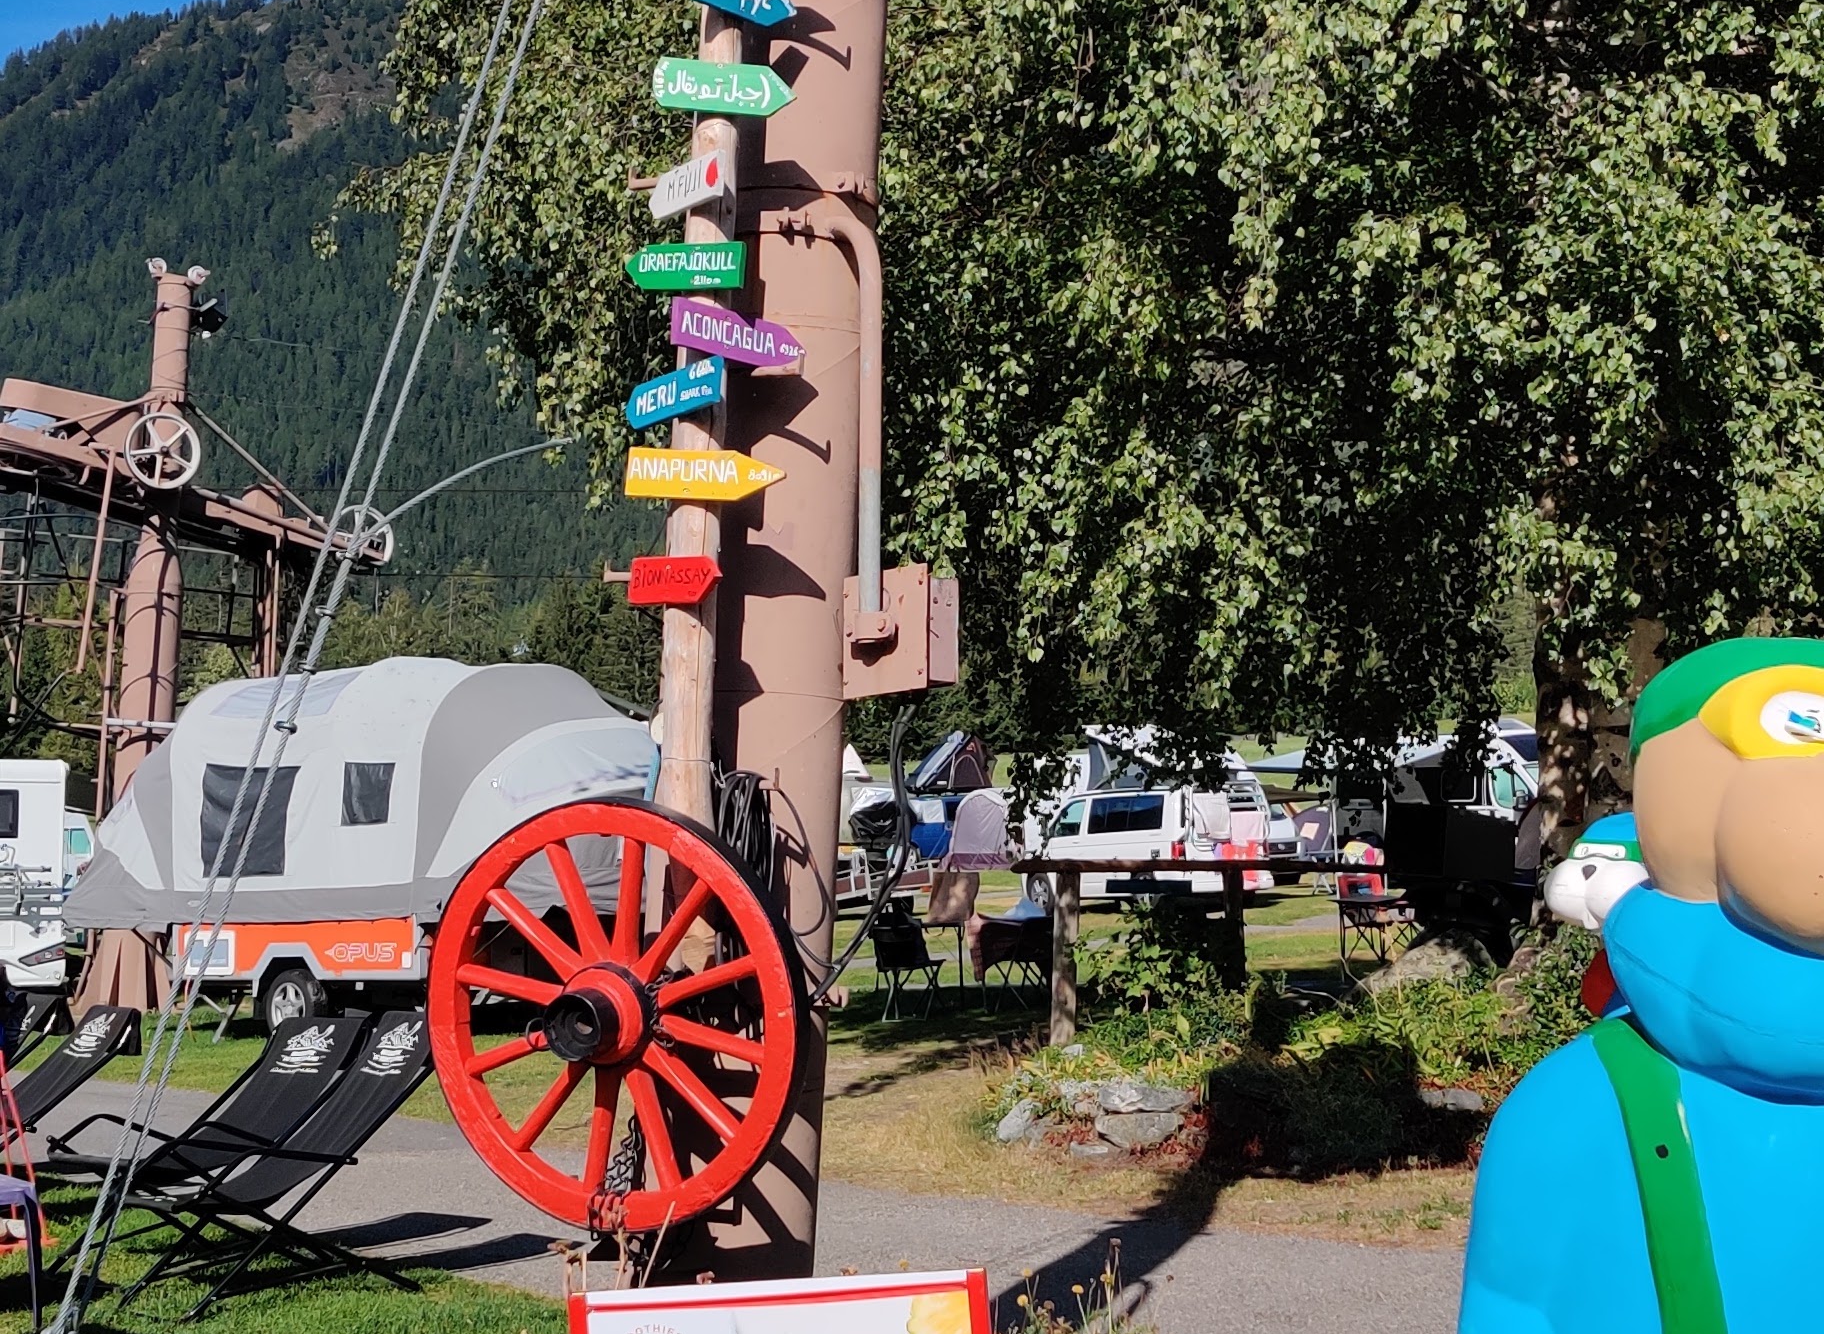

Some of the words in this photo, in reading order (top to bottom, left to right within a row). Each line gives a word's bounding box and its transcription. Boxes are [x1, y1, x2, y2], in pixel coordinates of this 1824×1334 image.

[681, 310, 776, 357] ACONCAGUA
[636, 380, 677, 416] MERU
[629, 456, 739, 484] ANAPURNA
[331, 942, 398, 963] OPUS
